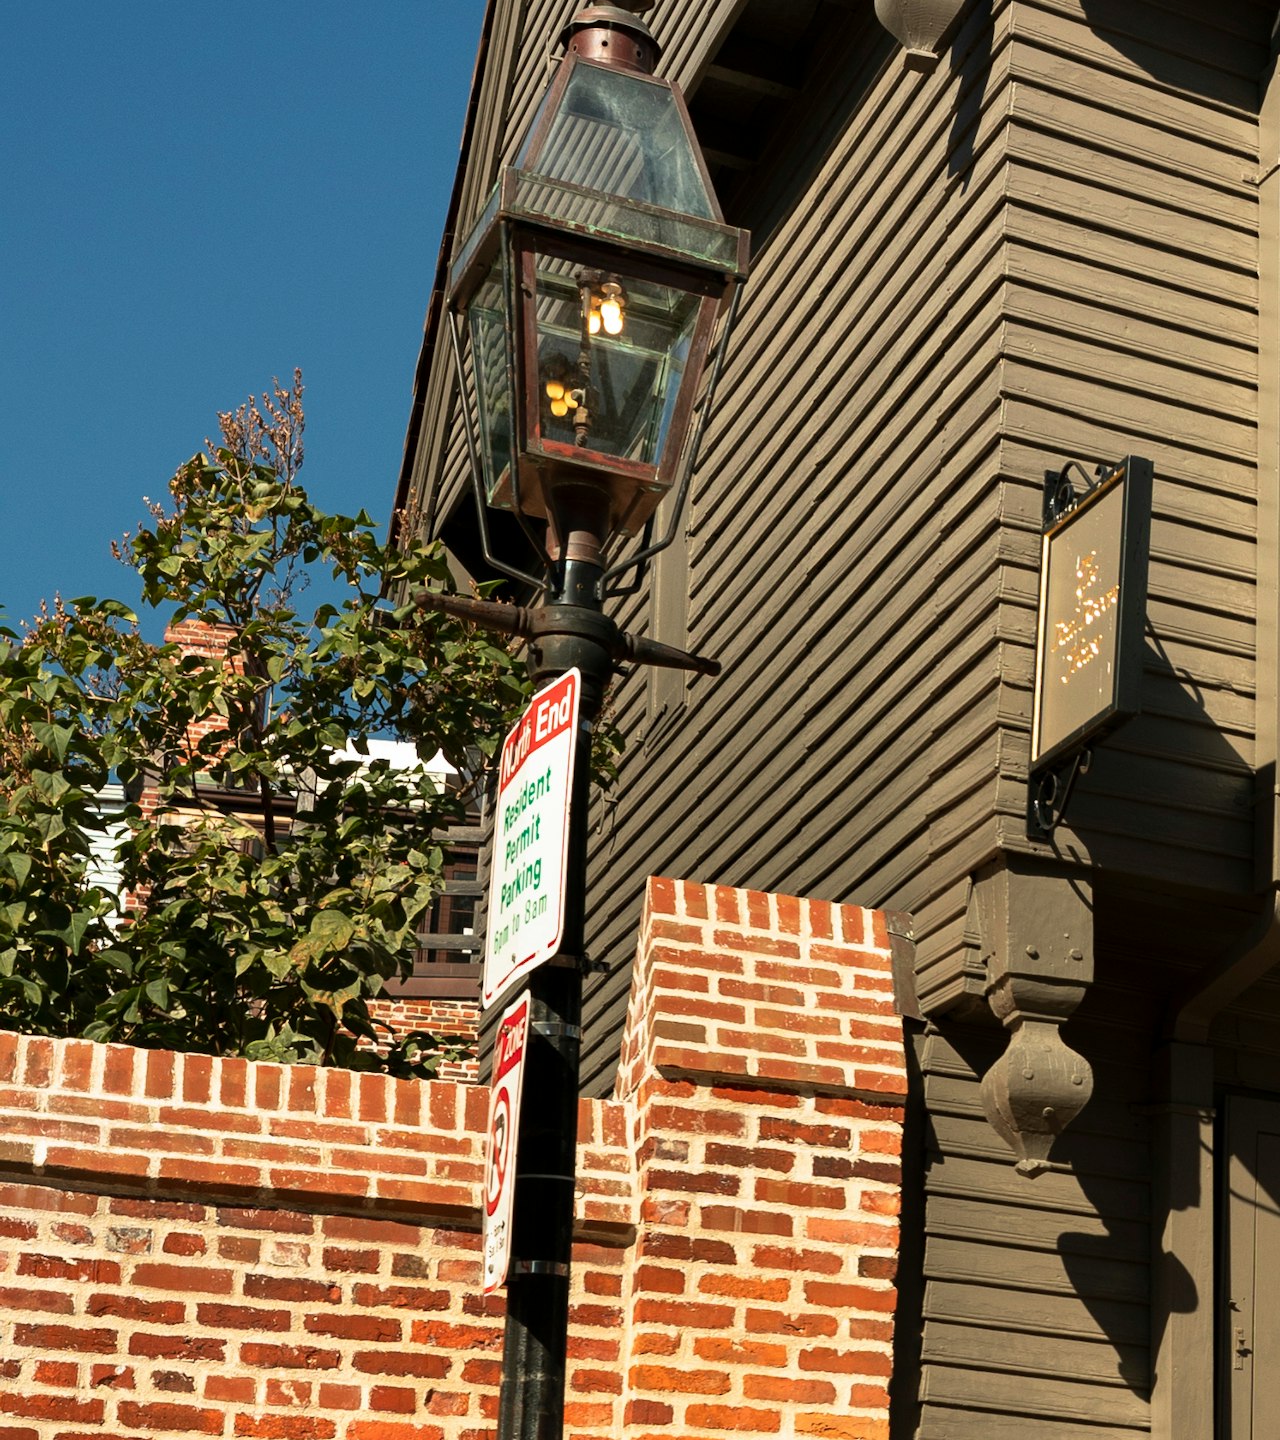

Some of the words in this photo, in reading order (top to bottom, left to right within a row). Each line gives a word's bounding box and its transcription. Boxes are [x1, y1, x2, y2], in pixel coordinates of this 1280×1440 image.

[503, 719, 532, 783] North
[535, 684, 572, 742] End
[503, 766, 551, 836] Resident
[505, 812, 541, 872] Permit
[500, 857, 542, 914] Parking
[494, 924, 509, 955] 6pm
[512, 913, 520, 936] to
[524, 893, 547, 924] 8am
